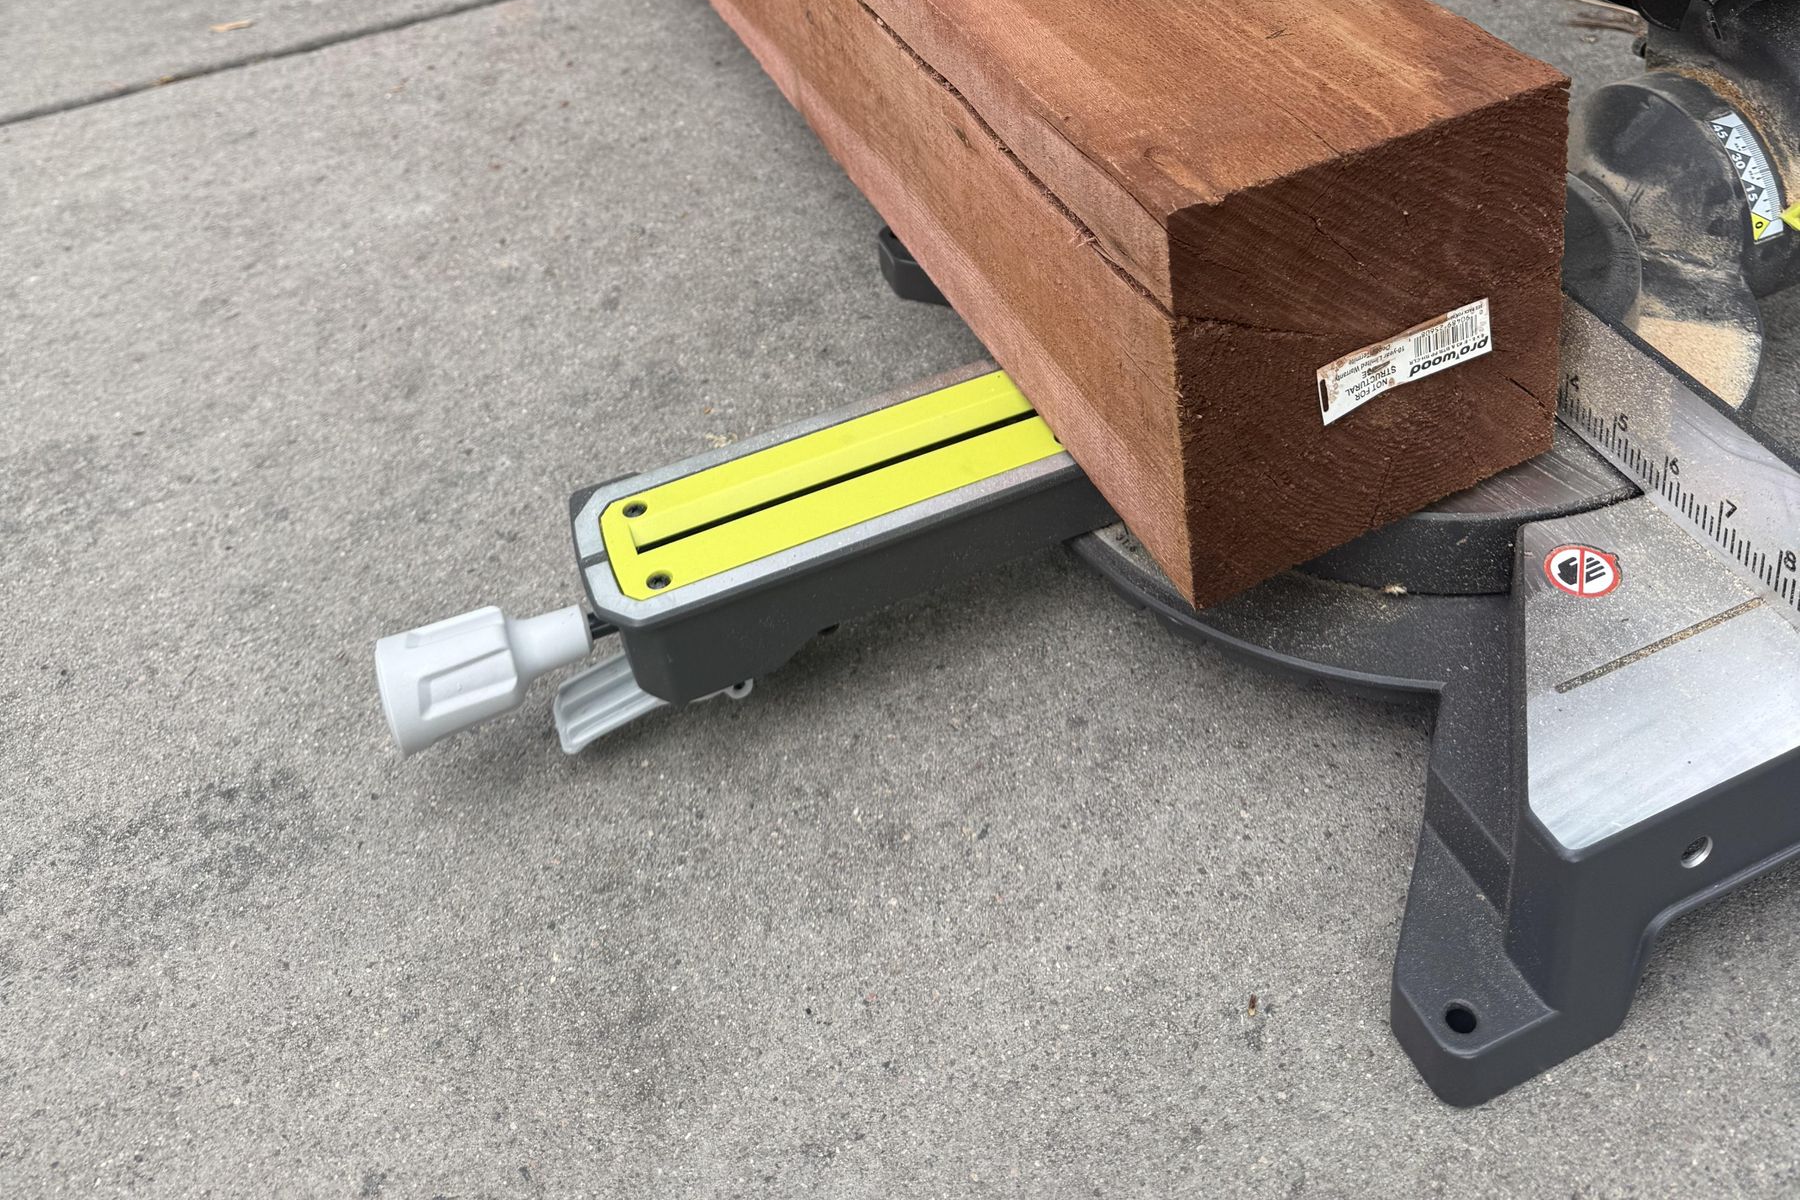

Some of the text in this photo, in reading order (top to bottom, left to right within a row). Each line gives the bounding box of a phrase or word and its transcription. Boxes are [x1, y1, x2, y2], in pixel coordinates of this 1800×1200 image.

[1711, 124, 1728, 139] 45
[1731, 153, 1746, 170] 30
[1746, 184, 1758, 202] 15
[1755, 221, 1764, 229] 0
[1335, 365, 1360, 381] Warranty
[1361, 355, 1383, 369] Limited
[1345, 365, 1397, 396] STRUCTURAL
[1355, 378, 1388, 401] NOT FOR
[1616, 412, 1629, 433] 5
[1668, 457, 1680, 476] 6
[1724, 499, 1738, 518] 7
[1783, 550, 1798, 573] 8
